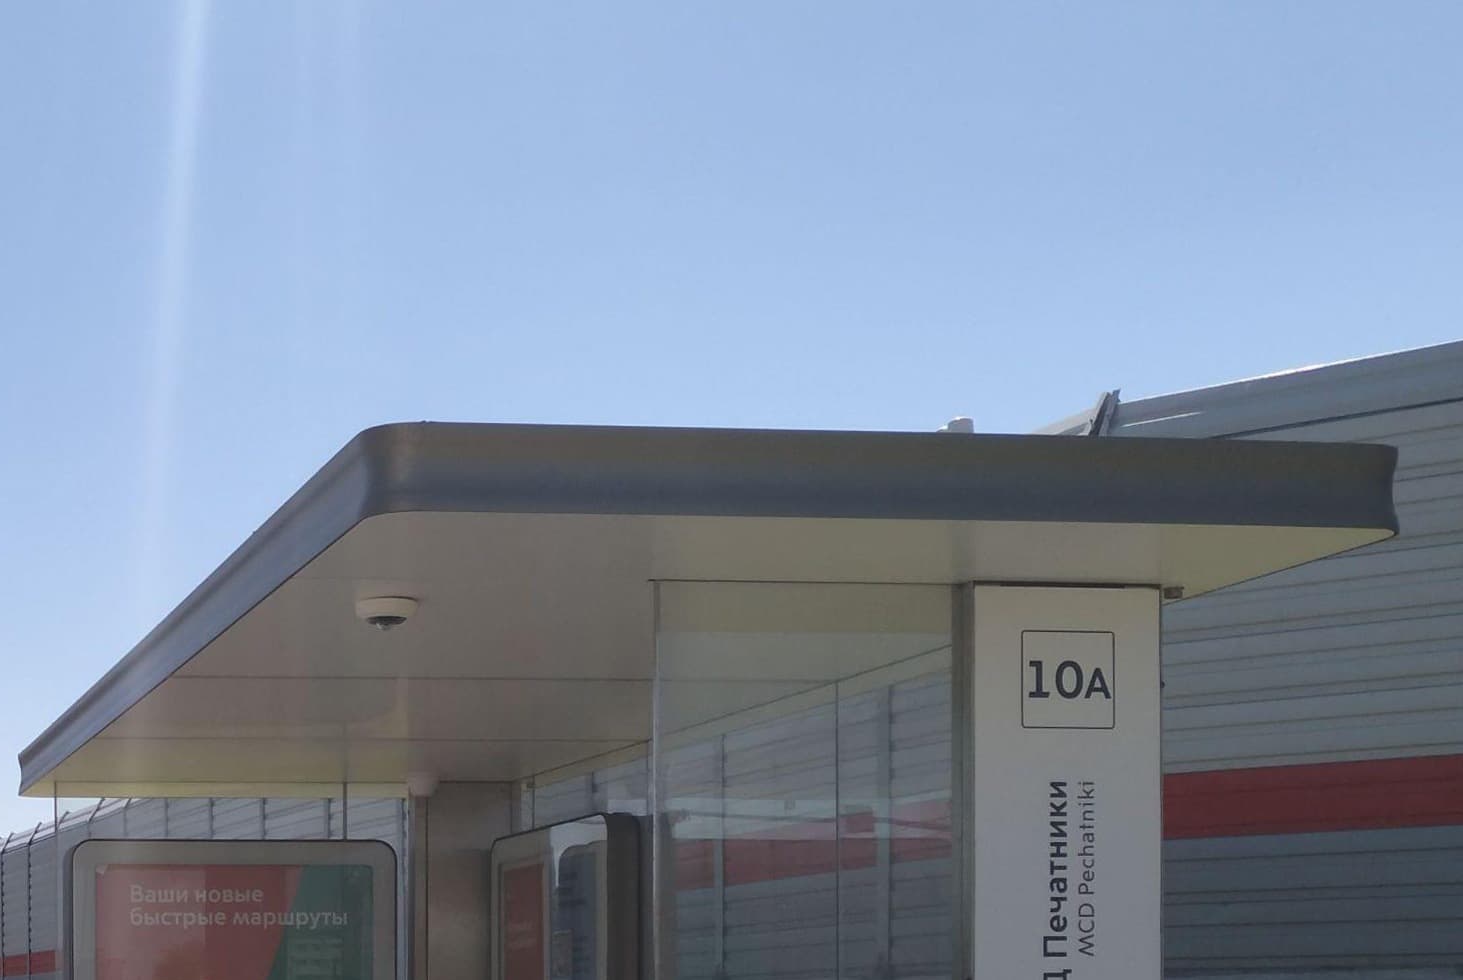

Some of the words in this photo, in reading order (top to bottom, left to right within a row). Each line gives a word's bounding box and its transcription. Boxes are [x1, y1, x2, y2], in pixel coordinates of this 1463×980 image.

[1028, 660, 1112, 699] 10А
[1077, 781, 1095, 894] Pechatniki
[1043, 781, 1068, 957] Печатники
[129, 885, 187, 903] Ваши
[195, 888, 264, 903] новые
[129, 907, 226, 928] быстрые
[232, 911, 348, 930] маршруты
[1077, 902, 1095, 957] MCD
